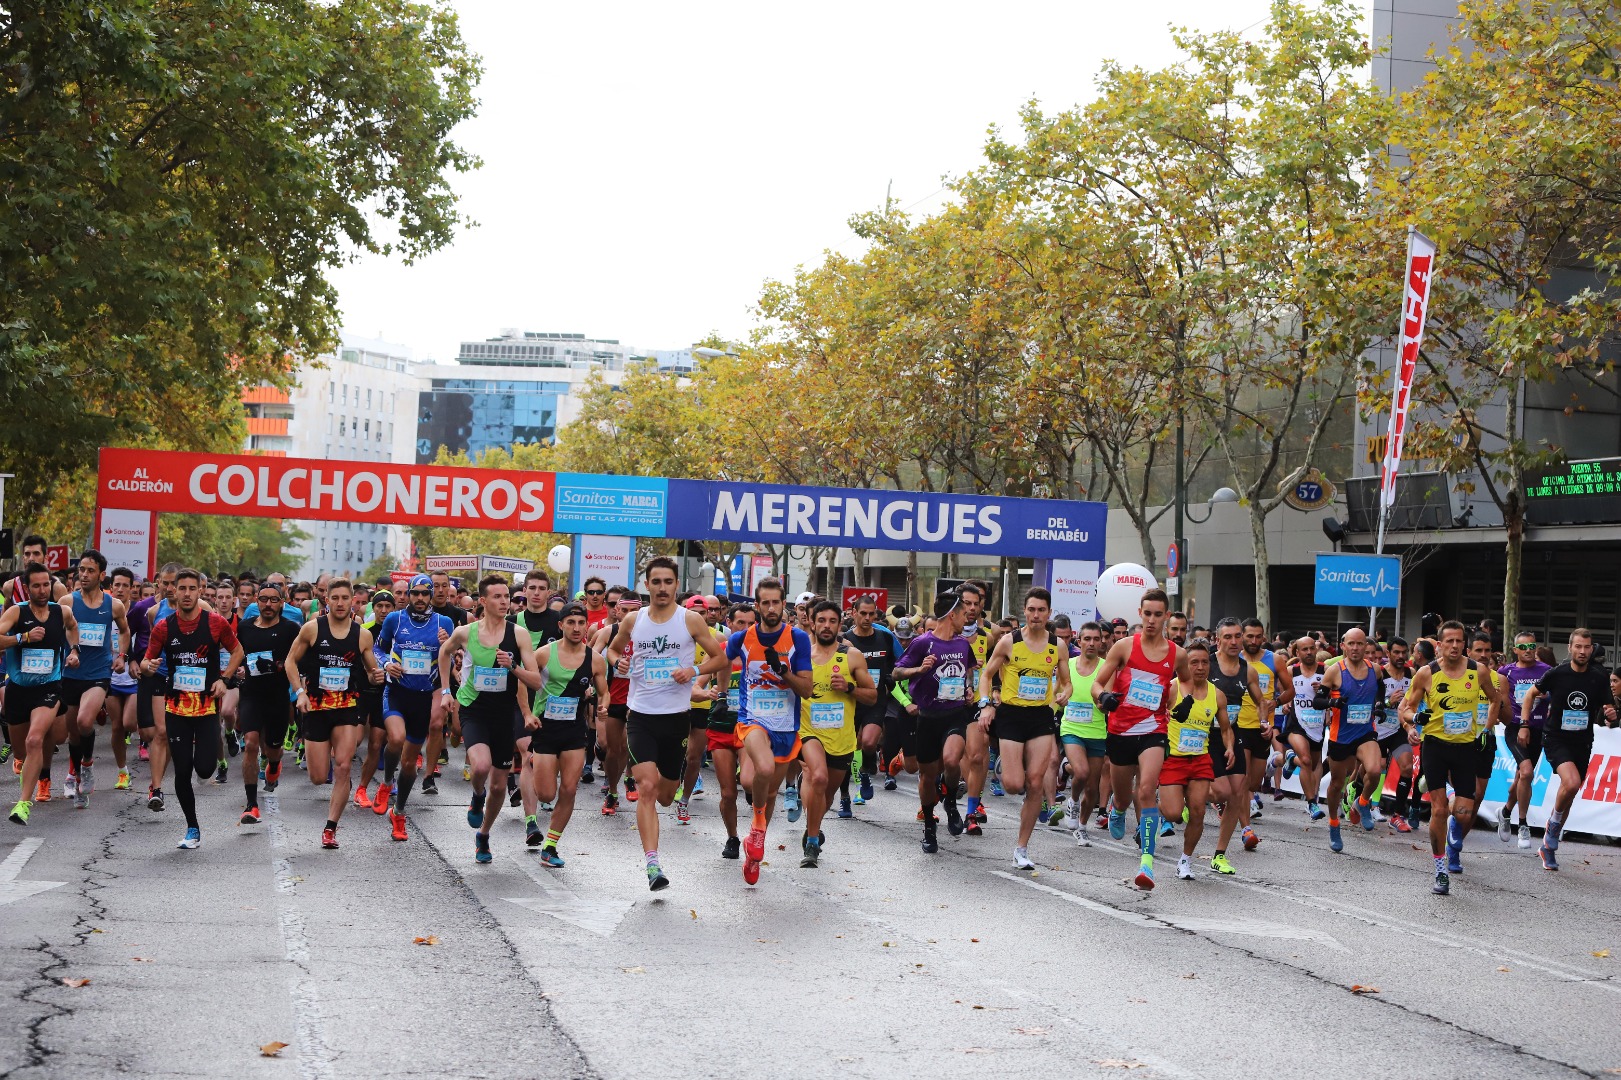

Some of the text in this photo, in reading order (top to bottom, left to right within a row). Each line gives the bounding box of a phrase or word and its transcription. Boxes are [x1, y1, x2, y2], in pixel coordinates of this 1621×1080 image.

[1593, 463, 1601, 473] 55
[133, 467, 149, 479] AL
[1606, 473, 1614, 482] AL
[108, 477, 174, 494] CALDERÓN
[189, 463, 545, 521] COLCHONEROS
[1298, 484, 1318, 499] 57
[1555, 486, 1559, 495] A
[562, 490, 658, 507] Sanitas MARCA
[711, 491, 1003, 546] MERENGUES
[1047, 517, 1069, 529] DEL
[113, 528, 145, 536] Santander
[1026, 527, 1089, 543] BERNABÉU
[428, 560, 475, 568] COLCHONEROS
[489, 560, 528, 570] MERENGUES
[1319, 568, 1371, 583] Sanitas
[1064, 578, 1094, 586] Santander
[1117, 575, 1145, 587] MARCA
[81, 632, 103, 641] 4014
[26, 659, 50, 668] 1370
[408, 660, 425, 669] 198
[178, 676, 201, 685] 1140
[325, 677, 345, 685] 1154
[484, 678, 498, 686] 65
[949, 687, 956, 695] 2
[1022, 686, 1046, 695] 2906
[1132, 691, 1160, 704] 4265
[758, 700, 784, 710] 1576
[550, 705, 575, 715] 5752
[814, 713, 843, 722] 6430
[1565, 718, 1587, 726] 9425
[1450, 720, 1468, 729] 220
[1182, 739, 1203, 748] 4286
